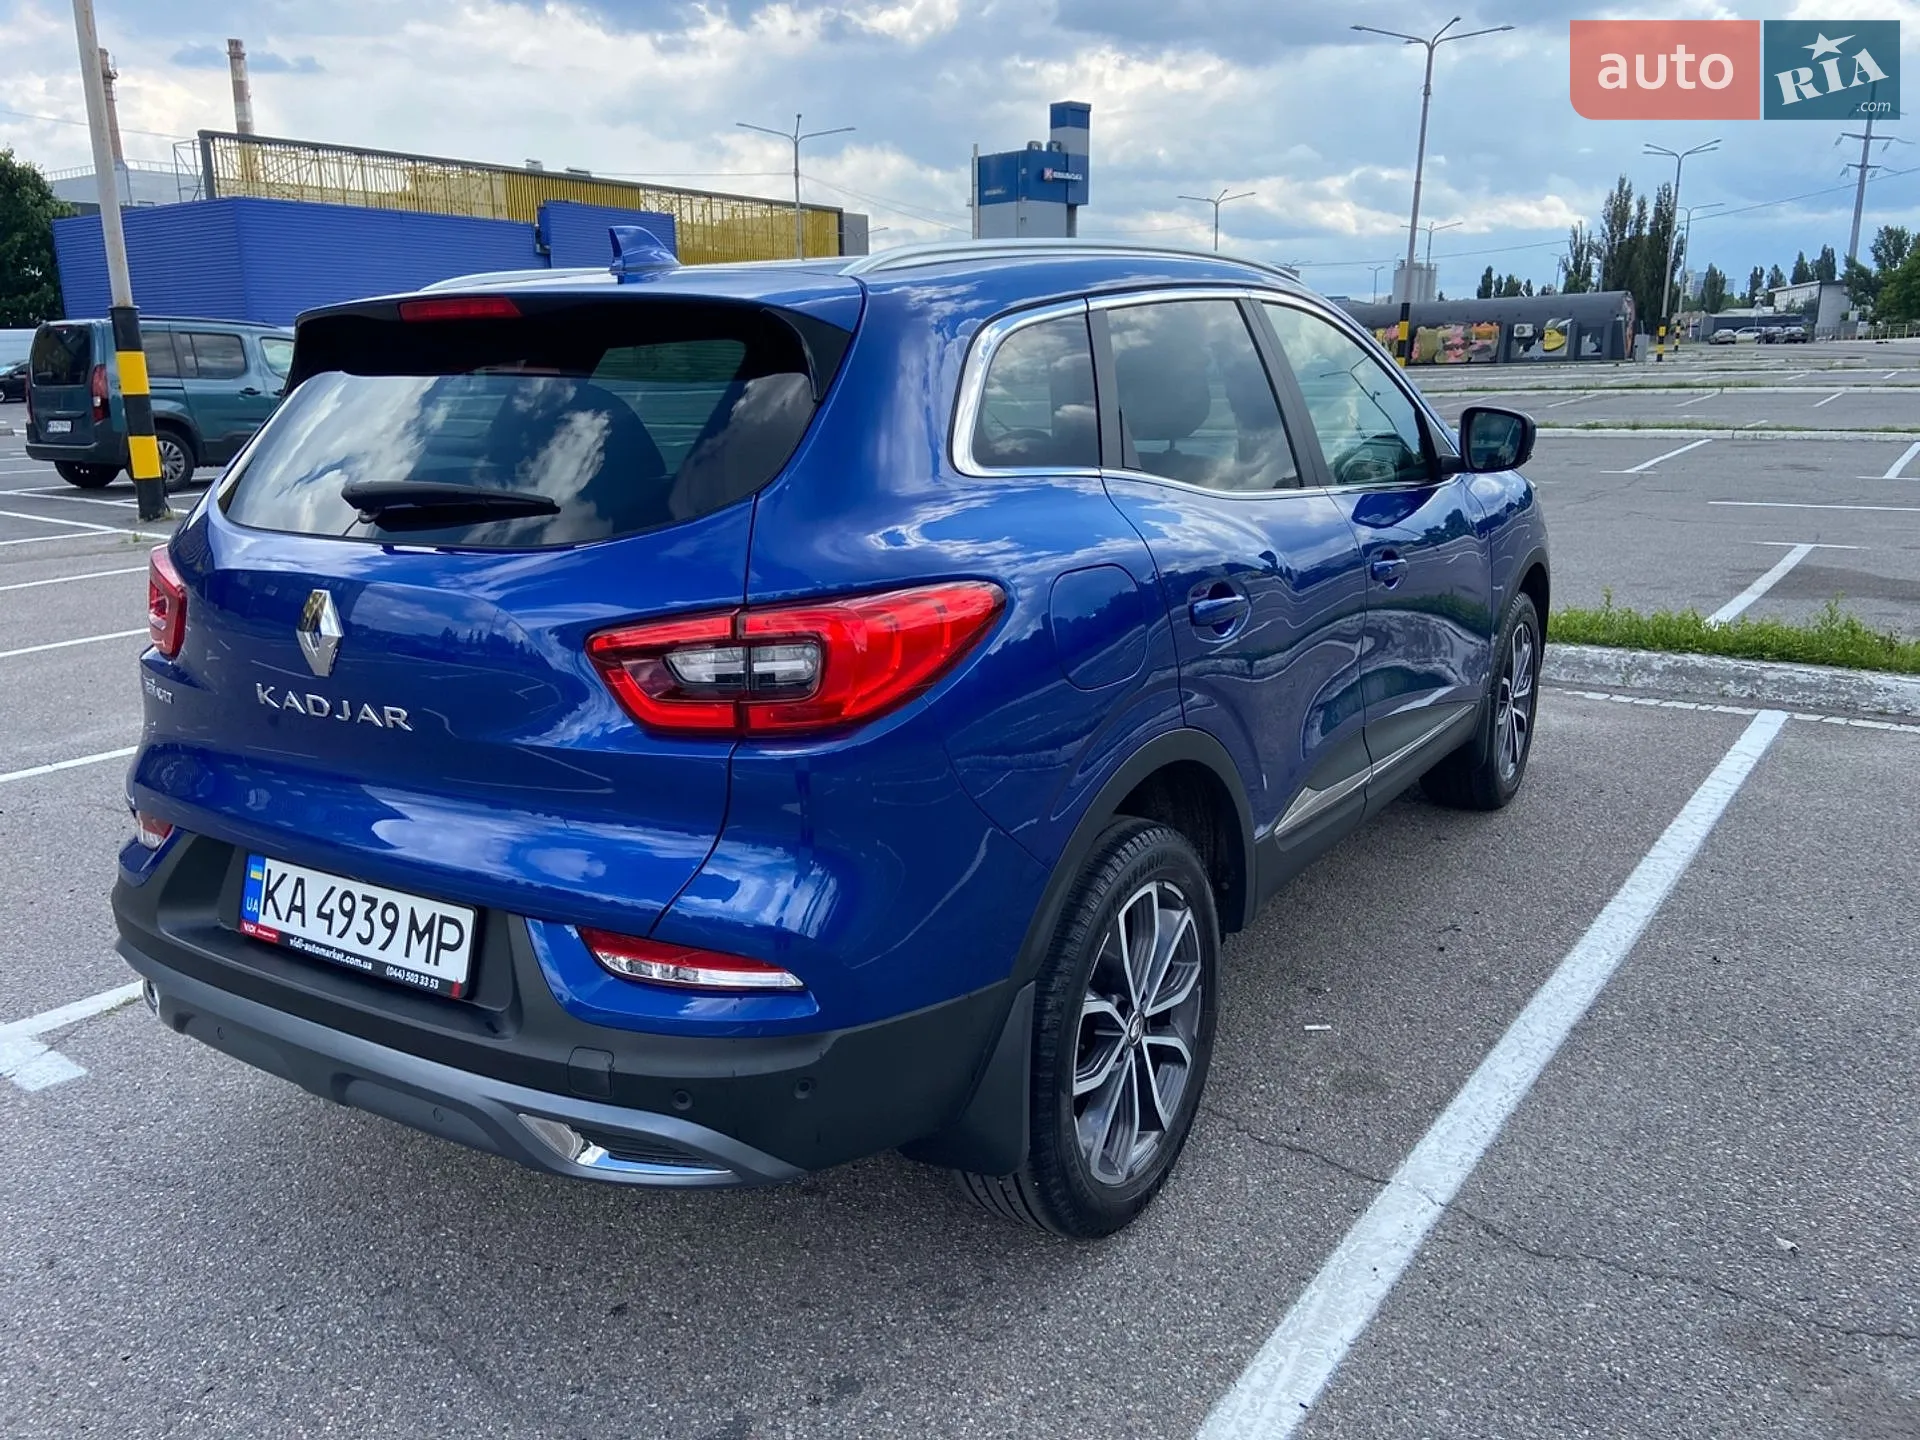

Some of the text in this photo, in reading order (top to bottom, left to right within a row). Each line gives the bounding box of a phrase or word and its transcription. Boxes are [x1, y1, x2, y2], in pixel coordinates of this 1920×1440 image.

[255, 682, 413, 732] KADJAR
[246, 896, 259, 913] UA
[261, 867, 466, 967] KA 4939 MP
[289, 937, 373, 970] vidi-automarket.com.ua
[385, 964, 440, 990] (044) 503 33 53
